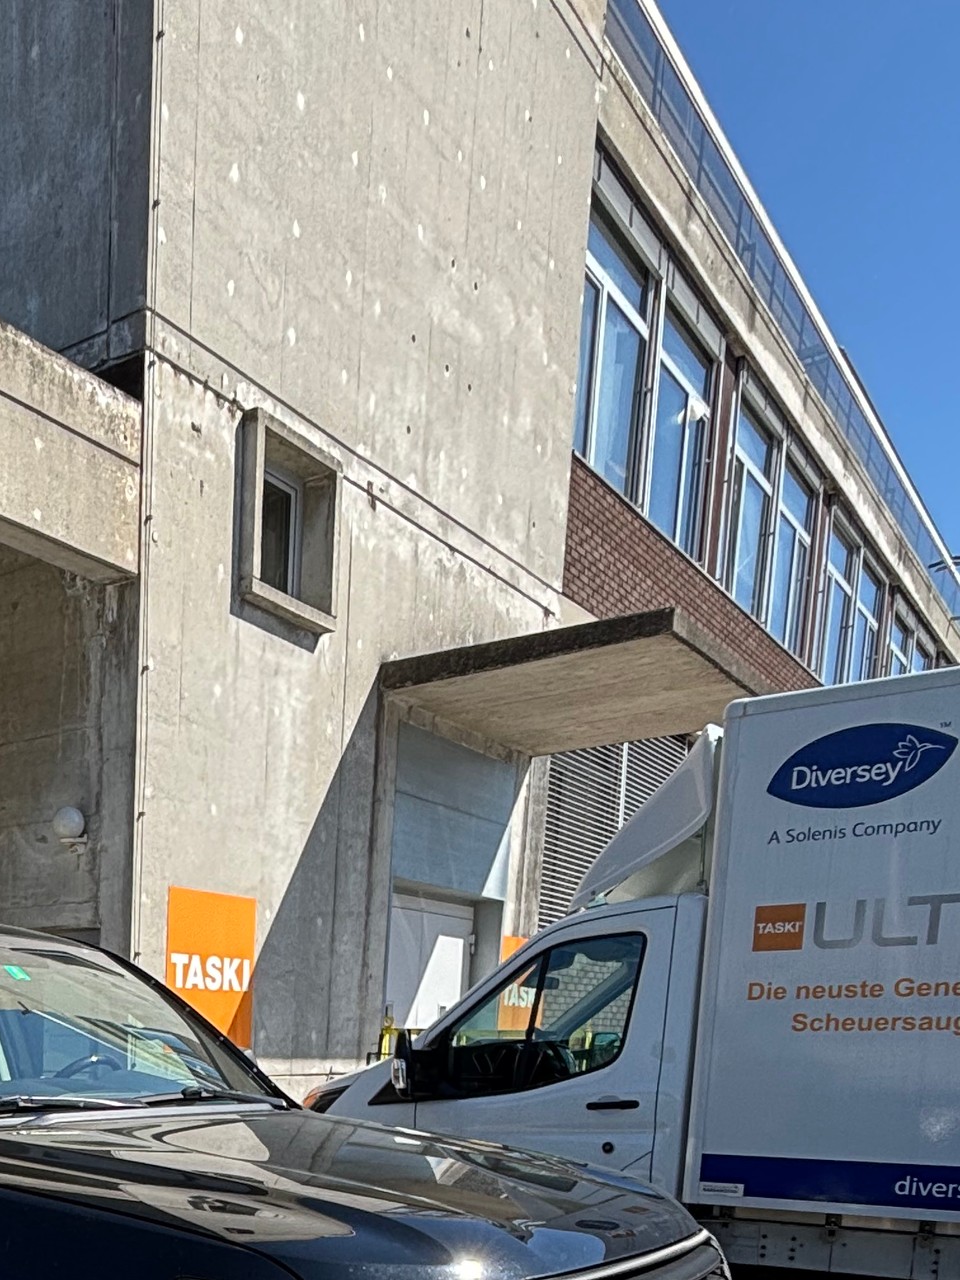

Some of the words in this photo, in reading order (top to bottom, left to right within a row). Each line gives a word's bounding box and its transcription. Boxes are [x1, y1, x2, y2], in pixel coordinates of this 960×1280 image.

[791, 760, 904, 790] Diversey
[767, 830, 781, 845] A
[785, 826, 847, 843] Solenis
[852, 819, 942, 838] Company
[756, 921, 800, 935] TASKI
[813, 893, 960, 950] ULT
[170, 952, 251, 992] TASKI
[502, 983, 537, 1008] TASK
[747, 982, 788, 1000] Die
[795, 980, 884, 999] neuste
